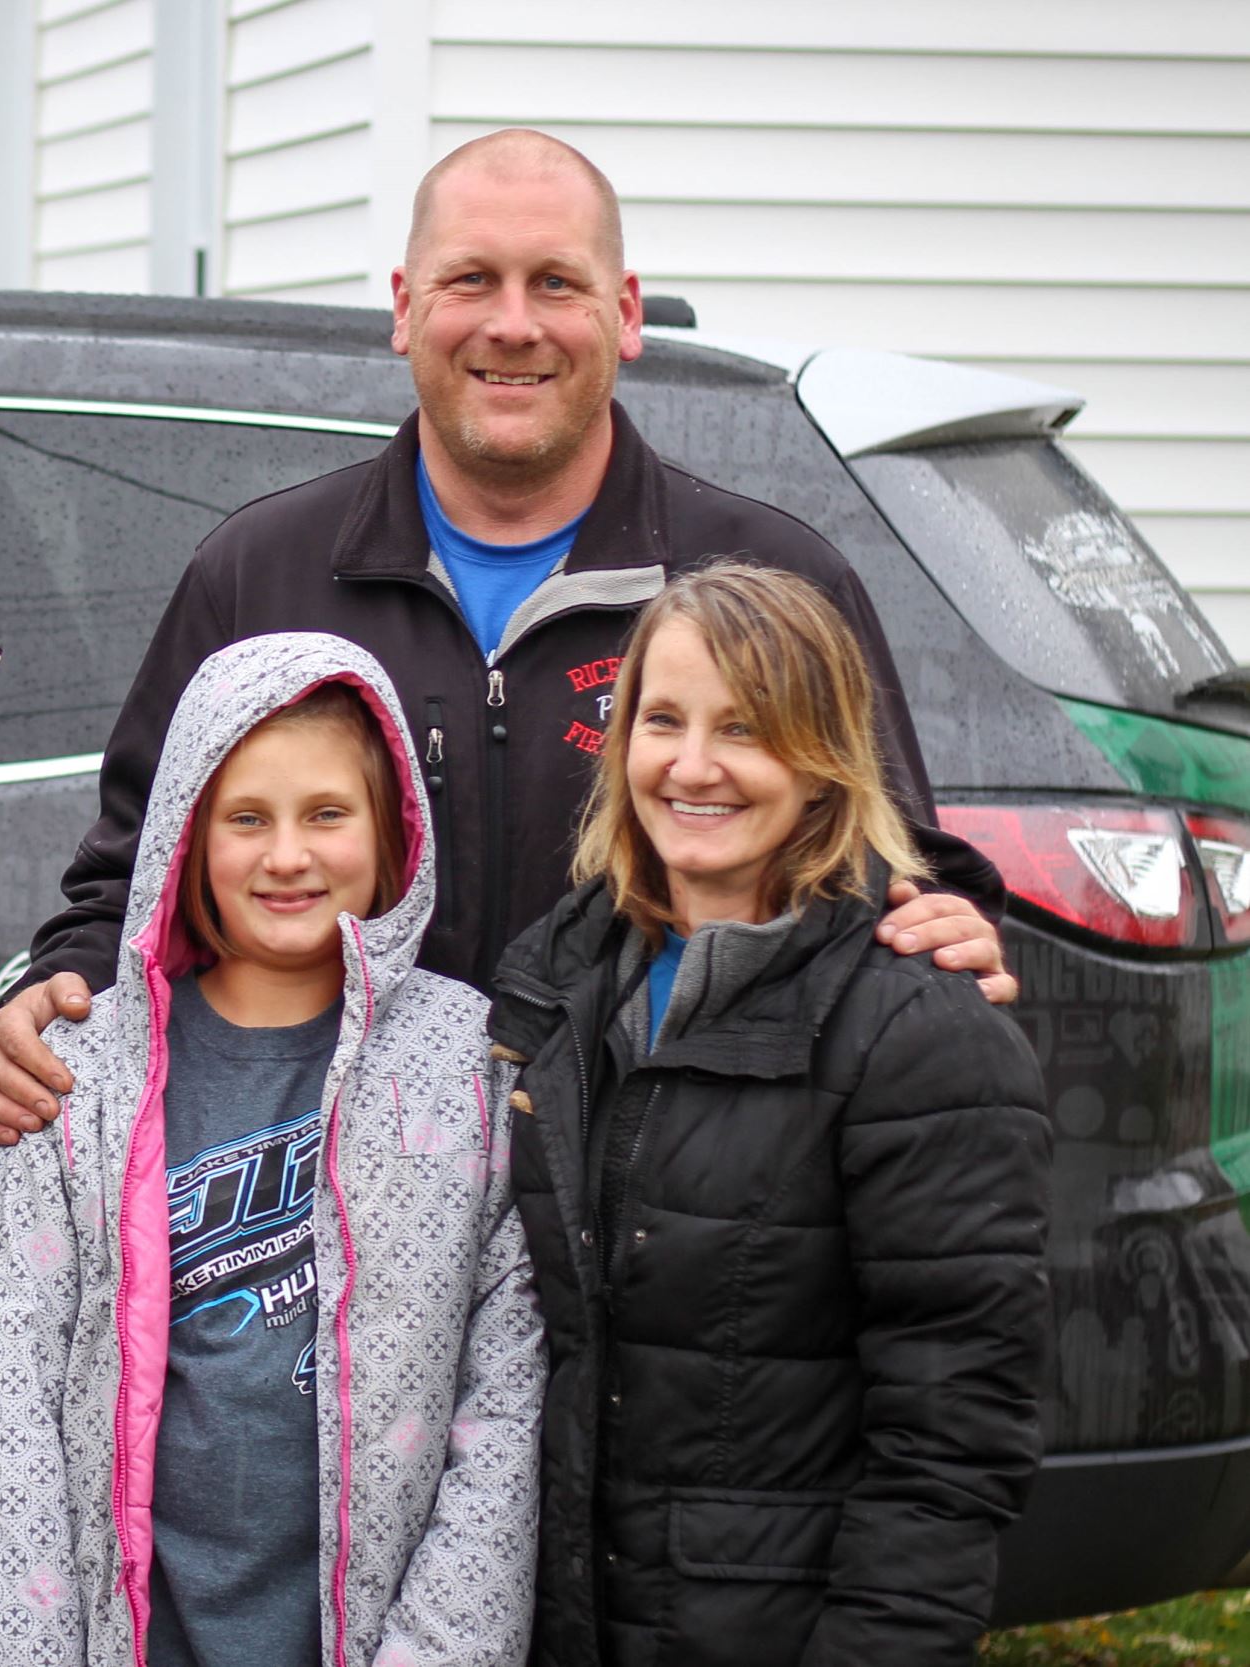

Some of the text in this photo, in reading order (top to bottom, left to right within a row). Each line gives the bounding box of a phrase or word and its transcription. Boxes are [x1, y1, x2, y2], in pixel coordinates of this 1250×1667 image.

[180, 1152, 240, 1185] JAKE
[242, 1131, 298, 1156] TIMM
[206, 1236, 281, 1277] TIMM
[265, 1297, 308, 1328] mind
